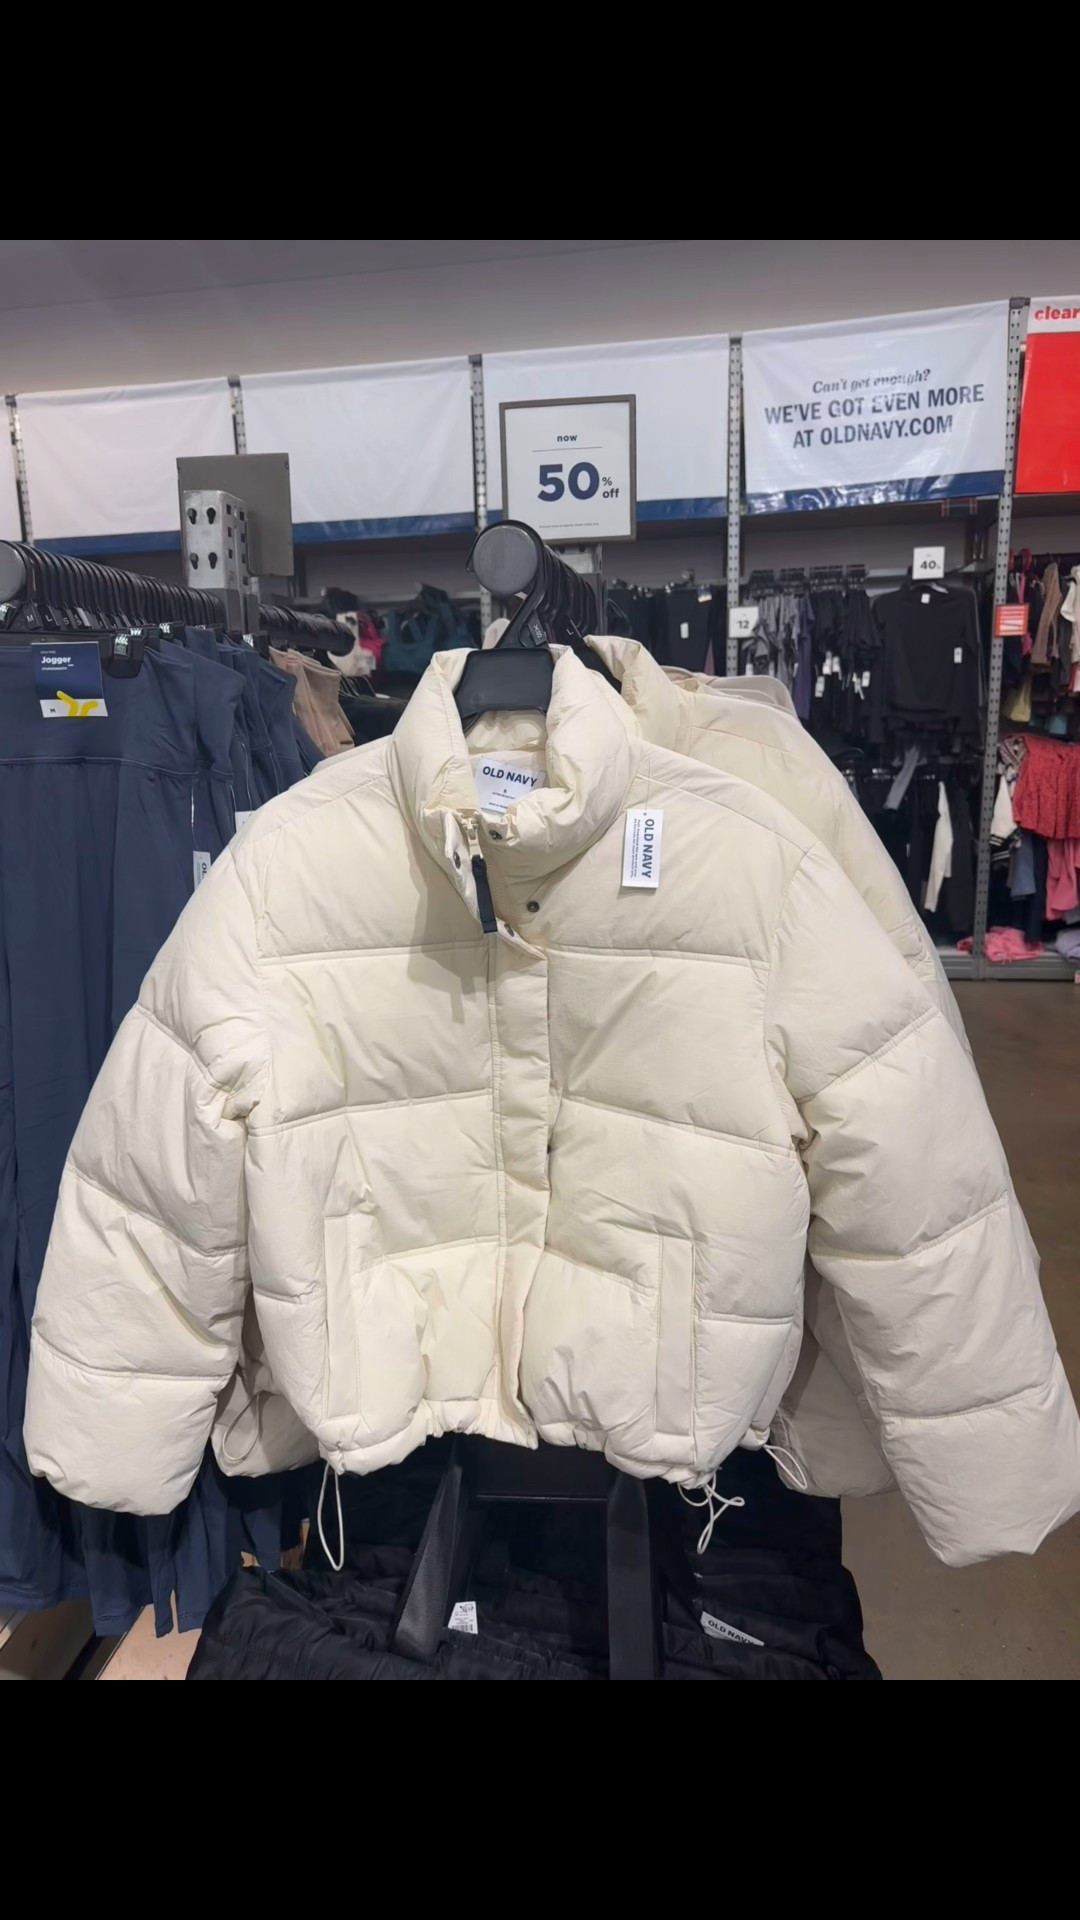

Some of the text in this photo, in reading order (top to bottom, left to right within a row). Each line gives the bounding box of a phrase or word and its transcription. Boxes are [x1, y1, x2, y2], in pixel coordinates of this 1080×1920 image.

[1034, 305, 1080, 320] clear
[812, 368, 931, 394] Can't get enough?
[765, 384, 985, 425] WE'VE GOT EVEN MORE
[557, 434, 578, 442] now
[793, 415, 953, 449] AT OLDNAVY.COM
[537, 461, 600, 502] 50
[602, 488, 620, 498] off
[41, 656, 72, 665] Jogger
[482, 766, 538, 787] OLD NAVY
[641, 818, 655, 879] OLD NAVY
[708, 1620, 727, 1633] OLD
